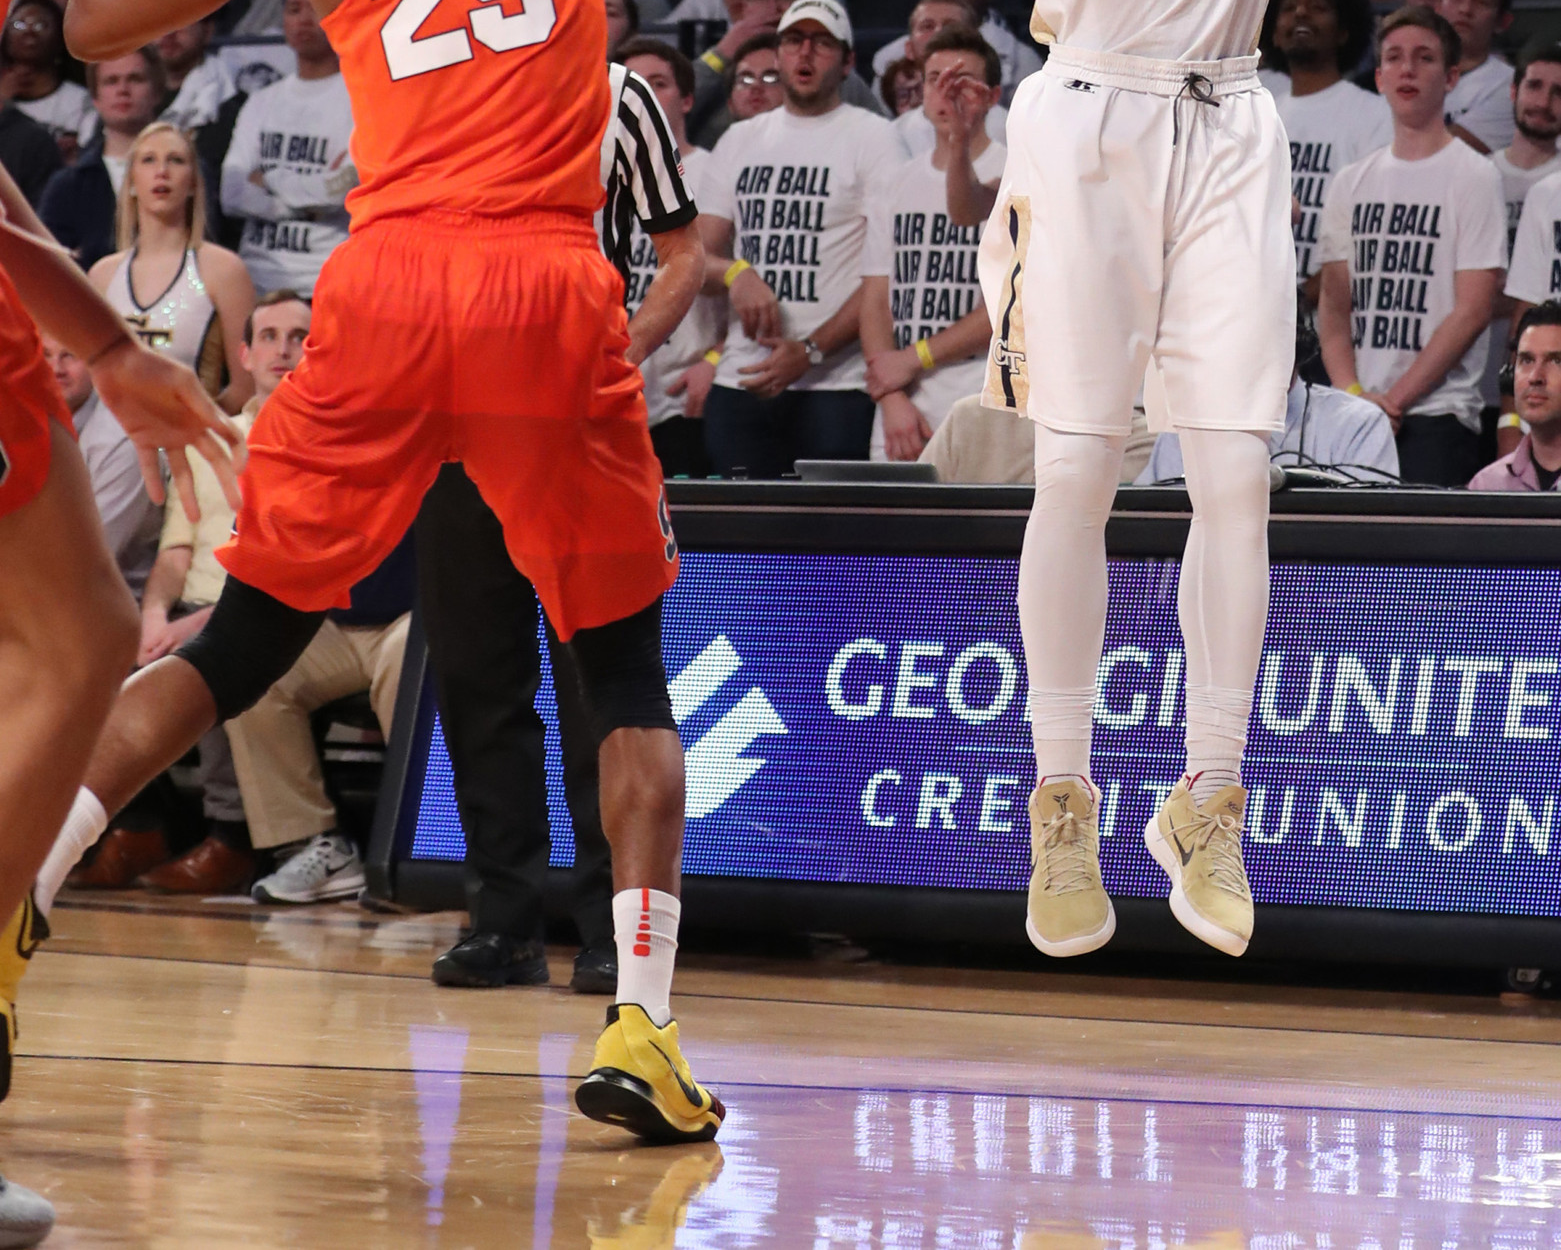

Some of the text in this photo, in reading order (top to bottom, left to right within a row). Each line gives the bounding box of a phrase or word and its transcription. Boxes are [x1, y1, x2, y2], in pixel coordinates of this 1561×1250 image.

[735, 166, 830, 197] AIR BALL
[770, 200, 825, 232] BALL
[894, 213, 981, 246] AIR BALL
[1352, 203, 1442, 238] AIR BALL
[764, 234, 821, 267] BALL
[925, 250, 980, 285] BALL
[1381, 240, 1435, 277] BALL
[1375, 277, 1428, 315] BALL
[1370, 315, 1423, 352] BALL
[825, 638, 1186, 730] GEOGI
[860, 769, 1555, 857] CREIT UNION
